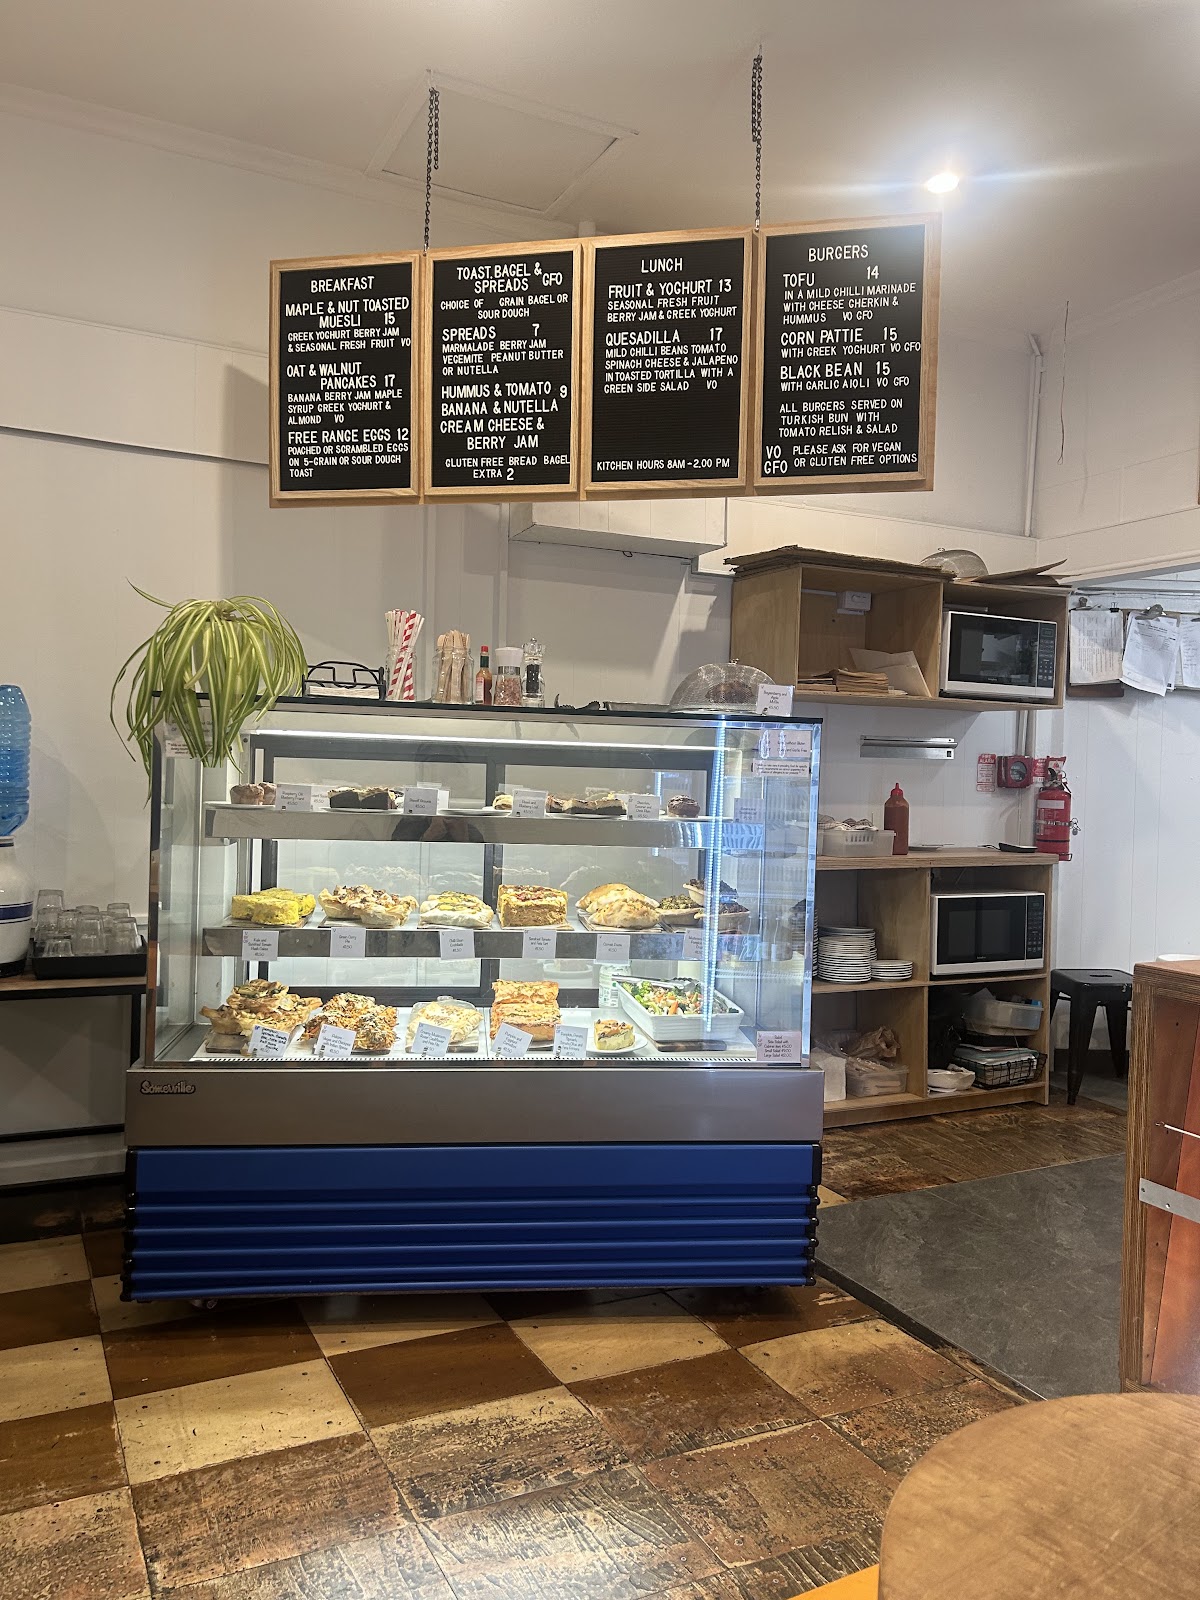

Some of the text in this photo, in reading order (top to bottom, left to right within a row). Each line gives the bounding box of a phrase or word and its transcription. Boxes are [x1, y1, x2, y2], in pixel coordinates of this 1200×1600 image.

[809, 245, 868, 262] BURGERS
[494, 263, 531, 278] BAGEL
[534, 262, 542, 276] &
[641, 258, 682, 273] LUNCH
[311, 276, 374, 293] BREAKFAST
[474, 272, 562, 294] SPREADS GFO
[783, 266, 879, 287] TOFU 14
[609, 279, 731, 298] FRUIT & YOGHURT 13
[785, 283, 916, 300] IN A MILD CHILLI MARINADE
[286, 297, 409, 316] MAPLE & NUT TOASTED
[441, 294, 568, 310] CHOICE OF GRAIN BAGEL OR
[608, 295, 719, 310] SEASONAL FRESH FRUIT
[784, 296, 898, 312] WITH CHEESE GHERKIN &
[319, 312, 395, 328] MUESLI 15
[607, 306, 737, 322] BERRY JAM & GREEK YOGHURT
[783, 310, 872, 324] HUMMUS VO GFO
[442, 324, 539, 341] SPREADS 7
[606, 328, 722, 346] QUESADILLA 17
[781, 327, 897, 346] CORN PATTIE 15
[288, 338, 411, 352] & SEASONAL FRESH FRUIT VO
[442, 339, 546, 353] MARMALADE BERRY JAM
[606, 343, 726, 358] MILD CHILLI BEANS TOMATO
[287, 362, 362, 377] OAT & WALNUT
[442, 364, 498, 376] OR NUTELLA
[605, 355, 738, 370] SPINACH CHEESE & JALAPENO
[781, 361, 890, 379] BLACK BEAN 15
[321, 374, 395, 390] PANCAKES 17
[442, 381, 567, 399] HUMMUS & TOMATO 9
[781, 376, 909, 391] WITH GARLIC AIOLI VO GFO
[288, 389, 402, 402] BANANA BERRY JAM MAPLE
[442, 398, 558, 416] BANANA & NUTELLA
[780, 399, 902, 413] ALL BURGERS SERVED ON
[288, 414, 344, 425] ALMOND VO
[440, 417, 544, 433] CREAM CHEESE &
[781, 412, 879, 425] TURKISH BUN WITH
[288, 428, 408, 444] FREE RANGE EGGS 12
[779, 423, 897, 437] TOMATO RELISH & SALAD
[288, 443, 408, 455] POACHED OR SCRAMBLED EGGS
[467, 435, 538, 450] BERRY JAM
[766, 442, 901, 459] VO PLEASE ASK FOR VEGAN
[445, 456, 570, 467] GLUTEN FREE BREAD BAGEL
[597, 461, 632, 470] KITCHEN
[637, 460, 664, 469] HOURS
[716, 458, 729, 467] PM
[764, 453, 917, 474] GFO OR GLUTEN FREE OPTIONS
[290, 468, 313, 477] TOAST
[473, 468, 514, 480] EXTRA 2
[141, 1080, 195, 1095] Somerville
